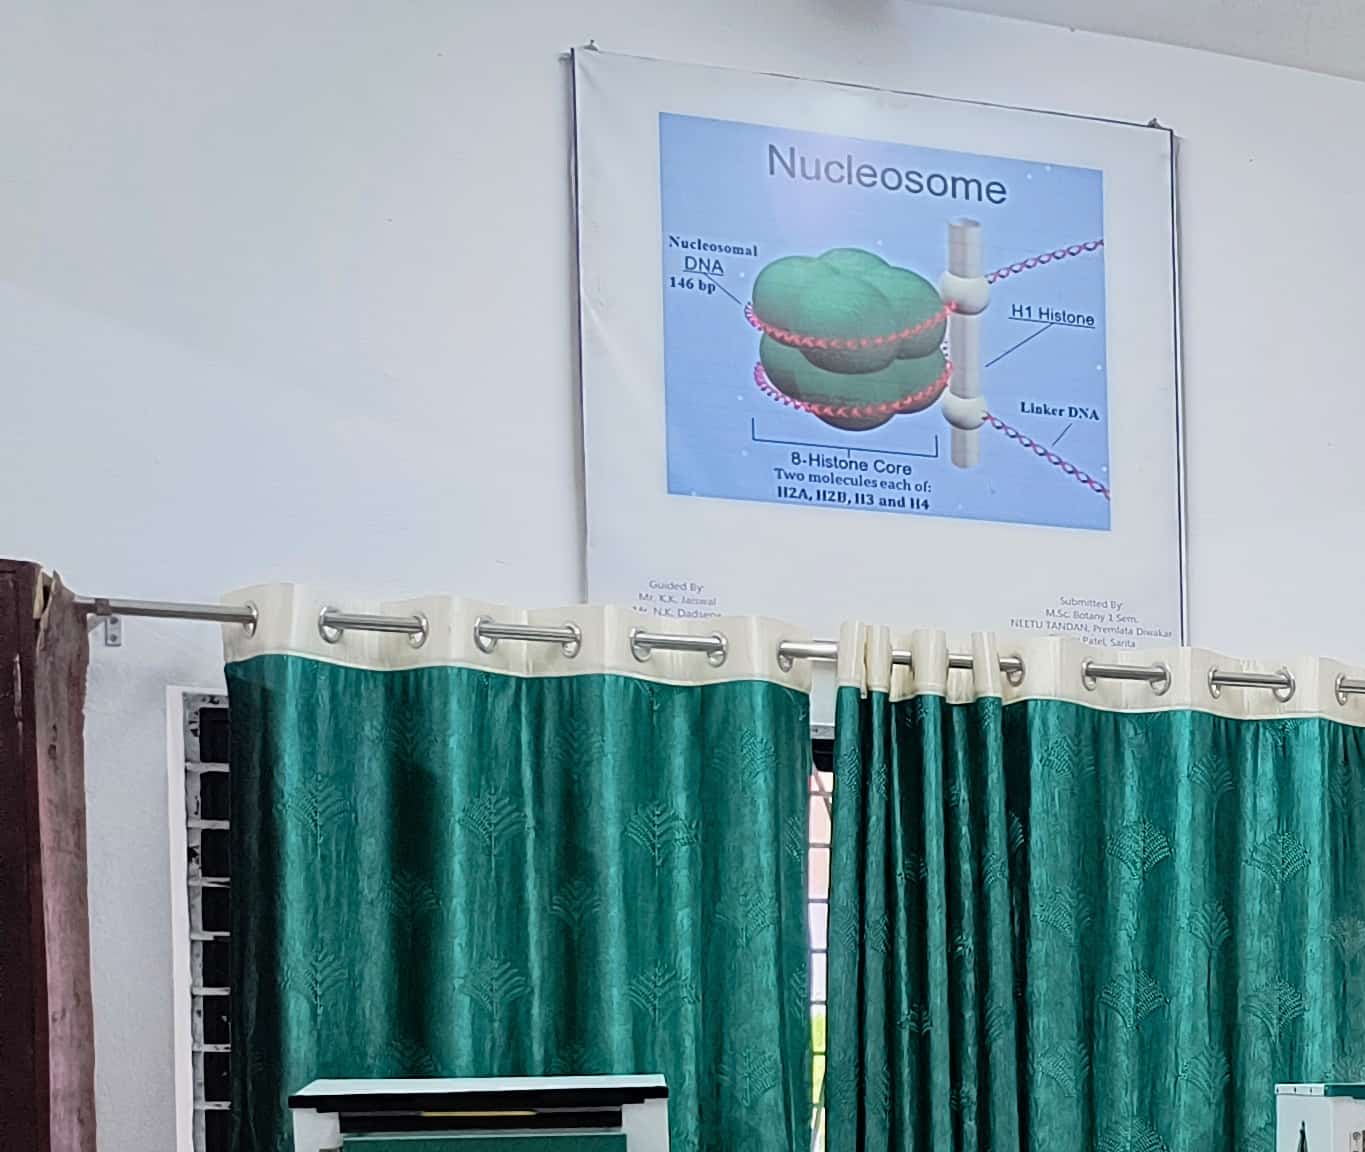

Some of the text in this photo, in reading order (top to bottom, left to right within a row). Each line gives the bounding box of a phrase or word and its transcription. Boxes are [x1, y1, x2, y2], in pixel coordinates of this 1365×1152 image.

[768, 143, 1007, 204] Nucleosome
[669, 235, 757, 256] Nucleosomal
[685, 256, 724, 273] DNA
[670, 276, 716, 295] 146 bp
[1012, 304, 1095, 326] H1 Histone
[1020, 401, 1100, 420] Linker DNA
[791, 451, 912, 476] 8-Histone Core
[774, 468, 932, 493] Two molecules each of:
[879, 496, 905, 509] and
[649, 580, 704, 594] Guided By
[1060, 596, 1123, 611] Submitted By
[1073, 611, 1105, 623] Botany
